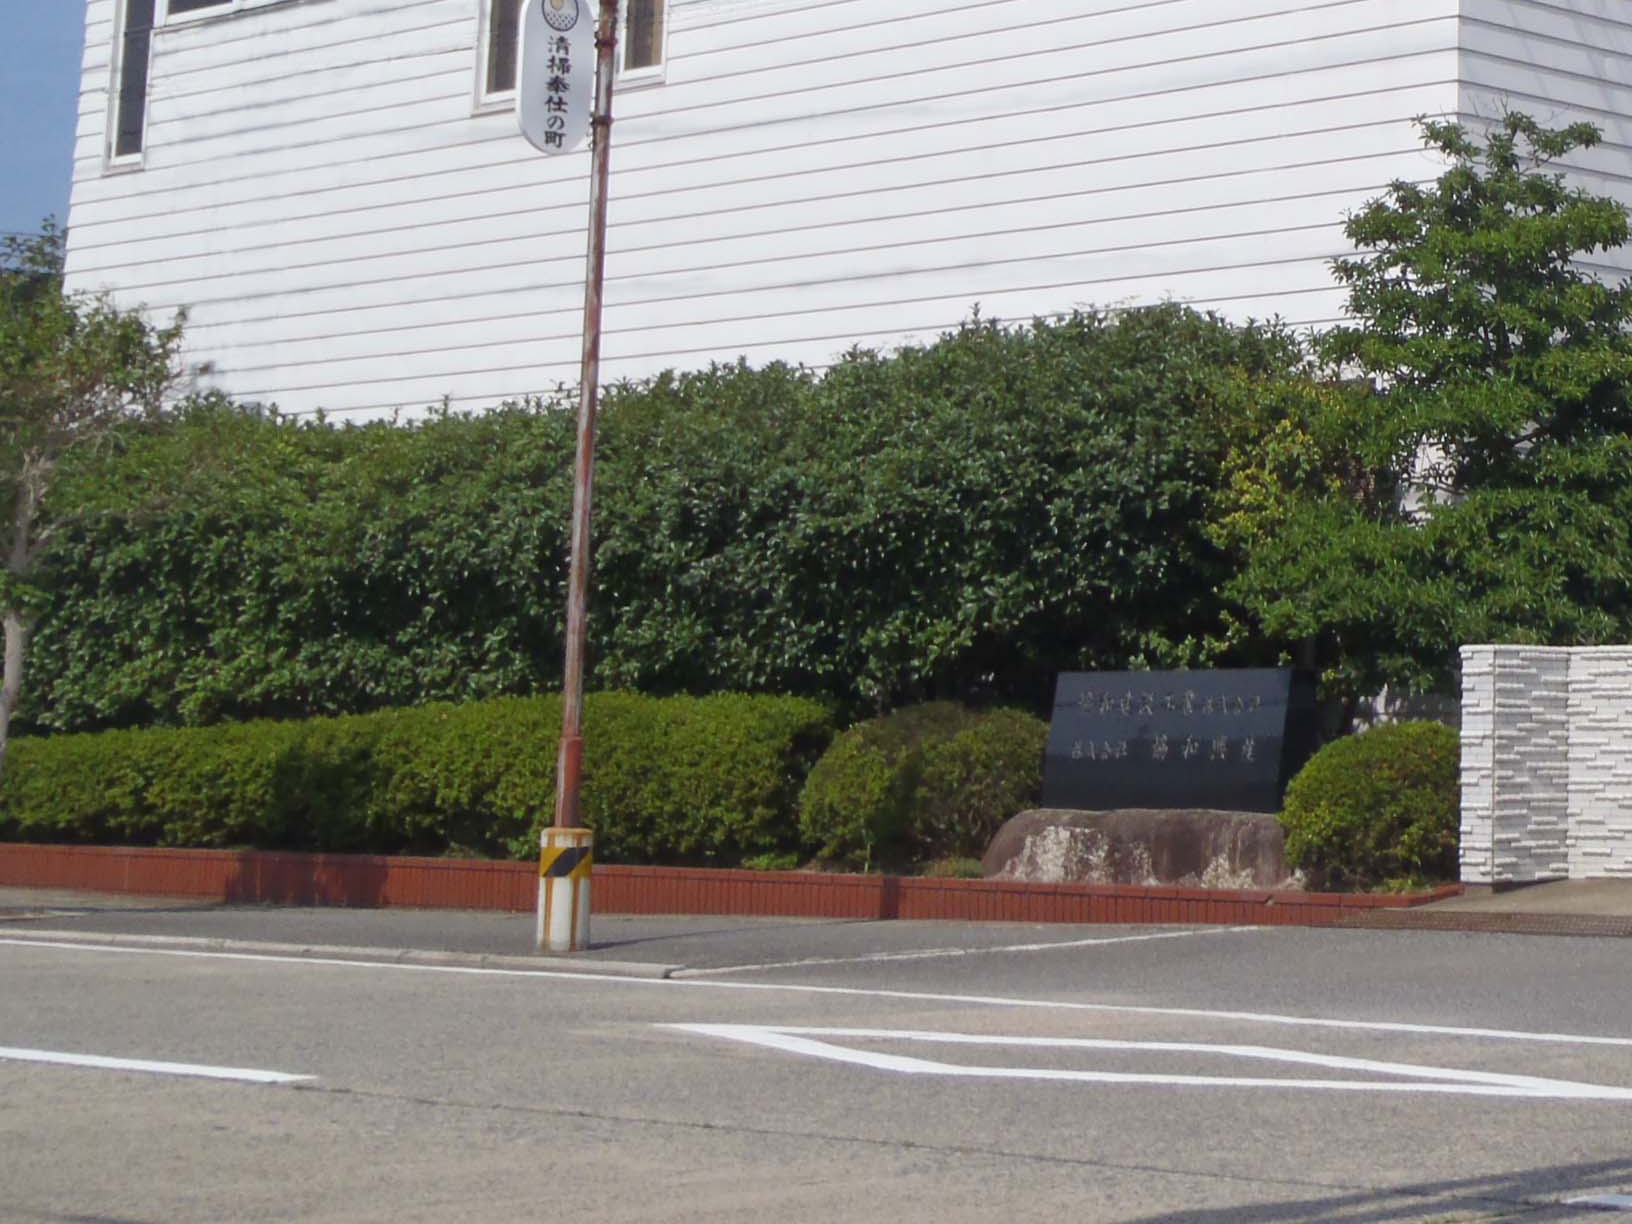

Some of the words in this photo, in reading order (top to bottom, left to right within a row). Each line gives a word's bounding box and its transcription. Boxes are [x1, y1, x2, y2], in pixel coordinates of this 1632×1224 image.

[545, 36, 572, 148] 清掃奉仕の町
